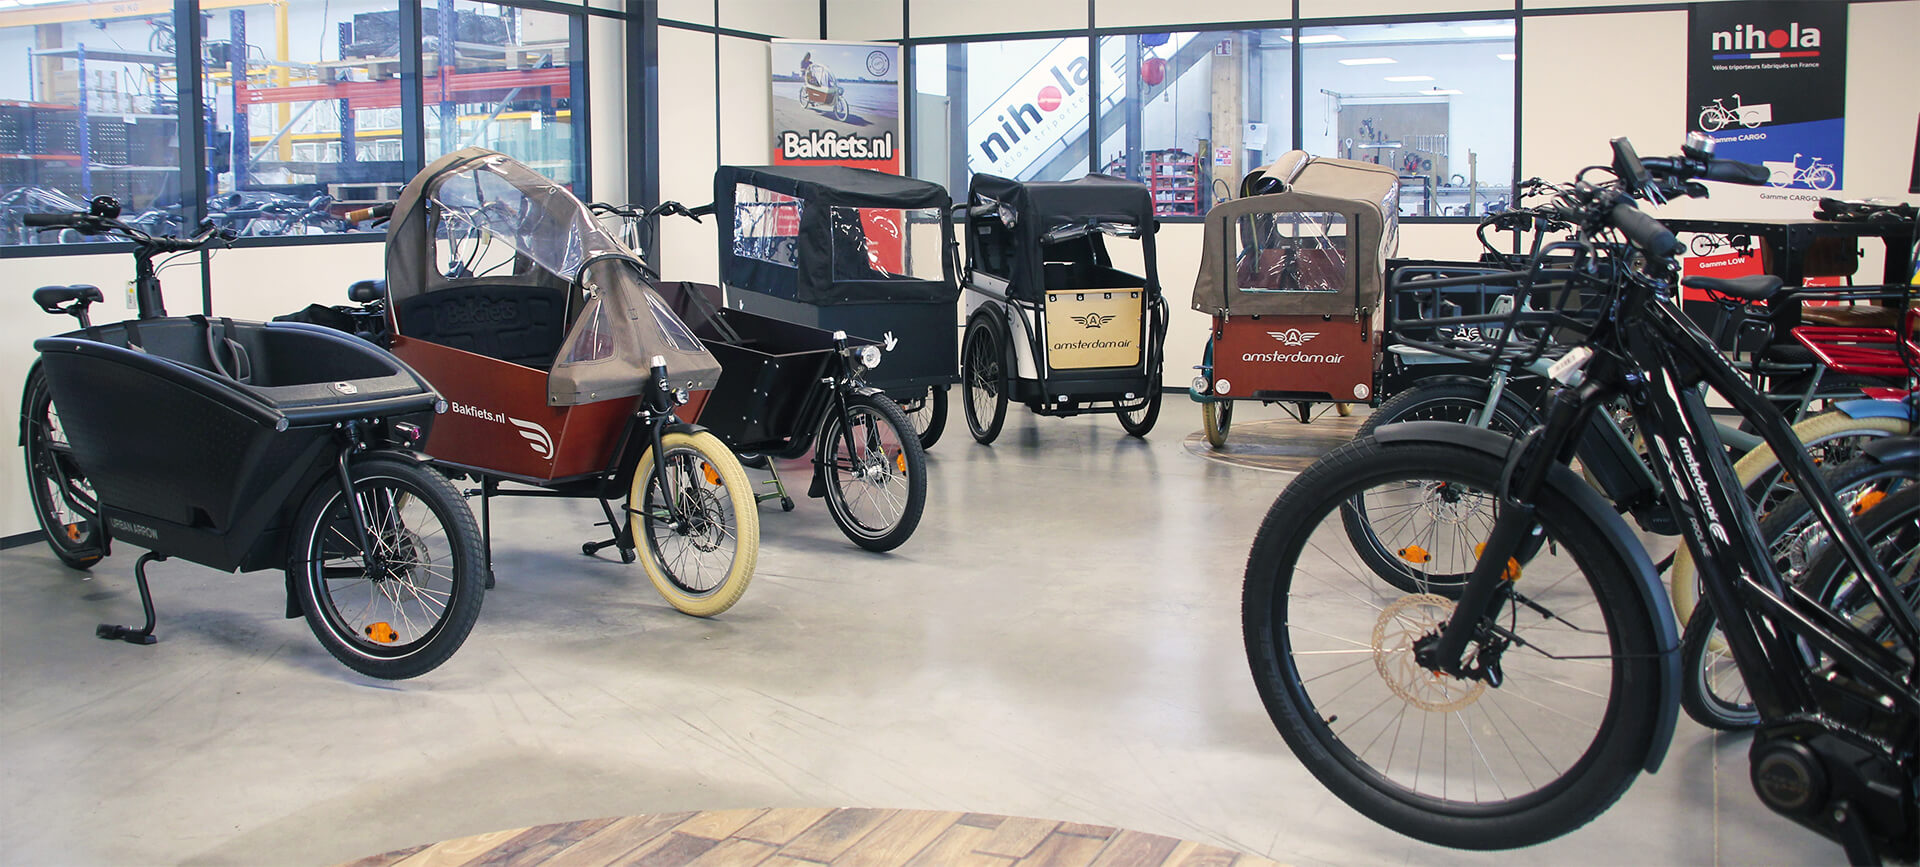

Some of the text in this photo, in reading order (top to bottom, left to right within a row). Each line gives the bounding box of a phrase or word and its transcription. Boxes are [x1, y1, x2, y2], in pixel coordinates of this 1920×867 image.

[1712, 22, 1821, 51] nihola
[980, 56, 1089, 163] nihola
[783, 131, 893, 159] Bakfiets.nl
[1738, 133, 1767, 141] CARGO
[1699, 257, 1746, 268] Gamme LOW
[1054, 340, 1132, 350] amsterdam air
[1242, 350, 1345, 363] amsterdam air
[451, 401, 506, 424] Bakfiets.nl
[1678, 437, 1712, 506] amsterdam
[109, 517, 158, 539] URBAN ARROW
